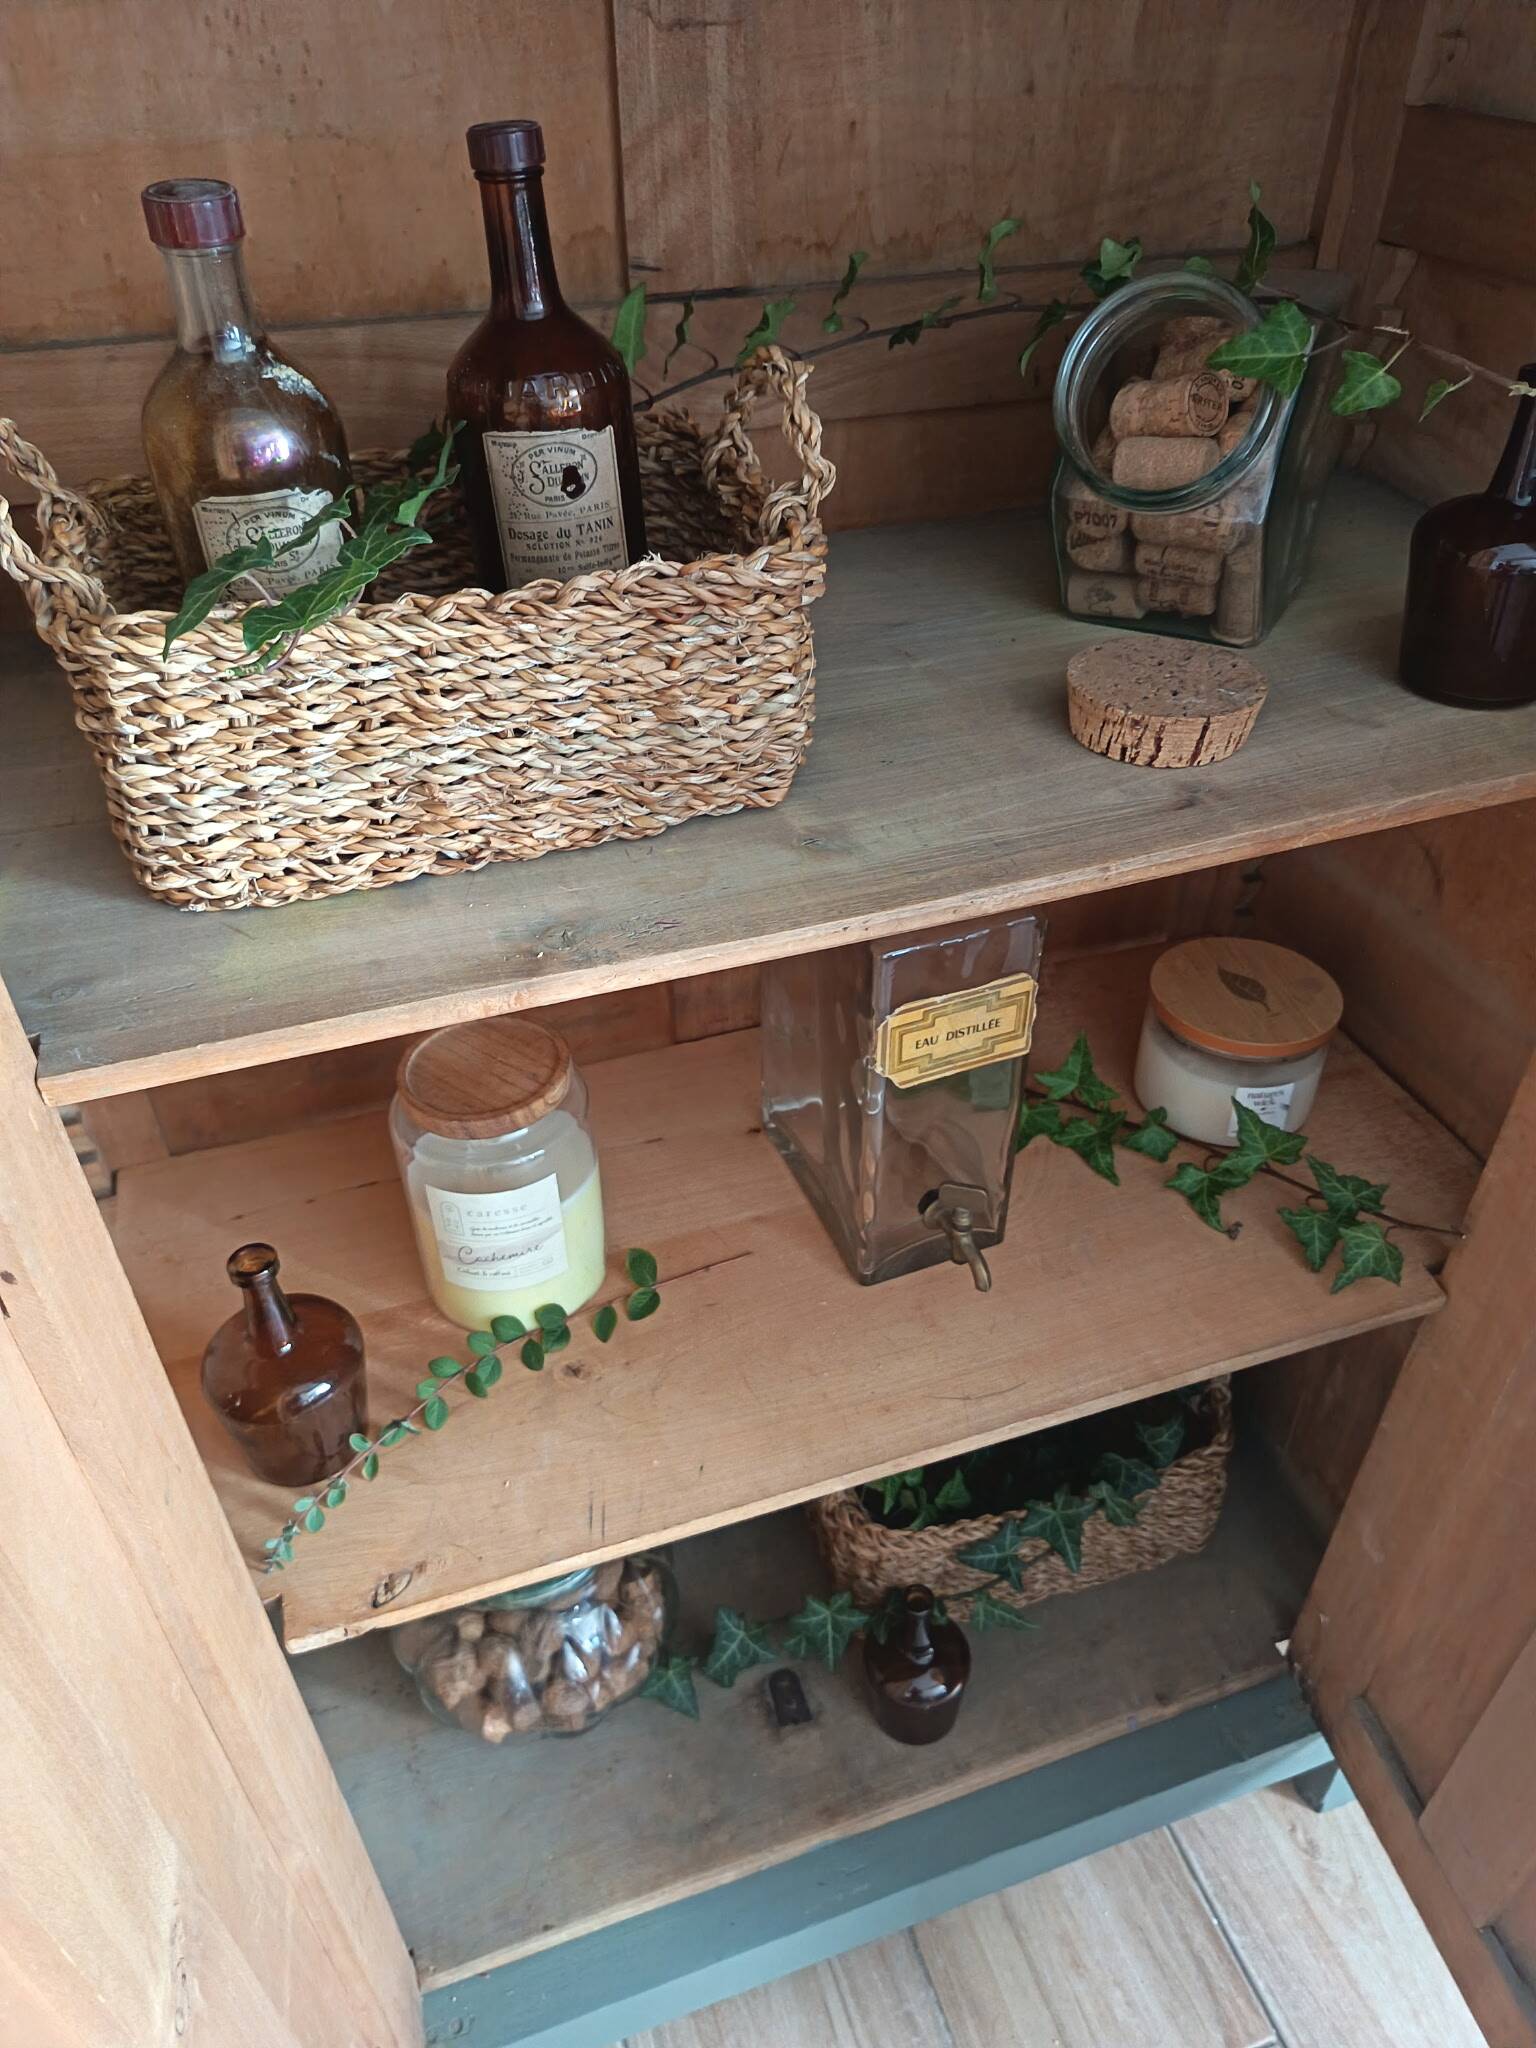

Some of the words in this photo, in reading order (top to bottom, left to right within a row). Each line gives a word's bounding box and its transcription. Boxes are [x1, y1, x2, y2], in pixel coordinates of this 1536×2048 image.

[547, 446, 576, 456] VINUM
[580, 501, 610, 514] PARIS
[264, 511, 296, 520] VINUM
[508, 527, 549, 542] Dosage
[556, 527, 571, 539] du
[576, 517, 614, 536] TANIN
[526, 541, 570, 551] SOLUTION
[915, 1035, 939, 1050] EAU
[946, 1018, 1001, 1042] DISTILLÉE
